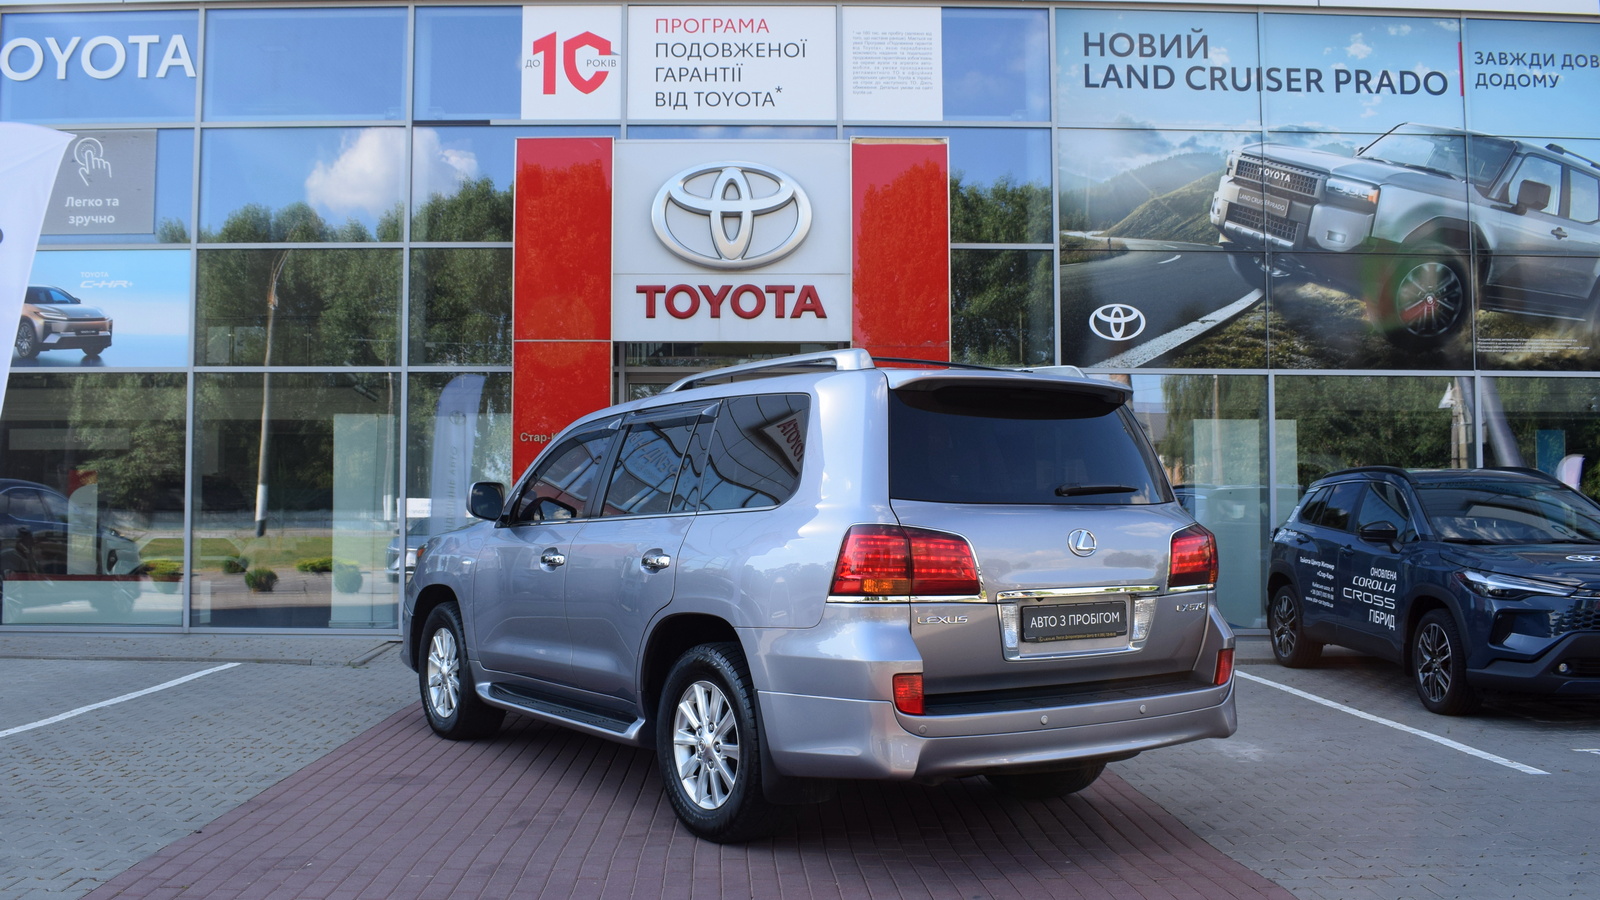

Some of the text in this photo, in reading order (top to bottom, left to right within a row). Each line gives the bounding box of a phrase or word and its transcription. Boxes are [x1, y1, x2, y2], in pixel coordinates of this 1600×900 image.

[655, 18, 770, 34] ПРОГРАМА
[655, 38, 808, 61] ПОДОВЖЕНОЇ
[1083, 28, 1209, 59] НОВИЙ
[525, 59, 541, 68] ДО
[586, 59, 617, 68] РОКІВ
[1474, 51, 1555, 70] ЗАВЖДИ
[655, 63, 744, 82] ГАРАНТІЇ
[1084, 64, 1448, 96] LAND CRUISER PRADO
[1475, 73, 1560, 90] ДОДОМУ
[655, 92, 688, 110] ВІД
[1258, 168, 1290, 182] TOYOTA
[64, 196, 120, 207] Легко та
[68, 215, 115, 226] зручно
[636, 284, 828, 319] TOYOTA
[1370, 567, 1397, 580] ОНОВЛЕНА
[1352, 576, 1396, 593] COROLLA
[1343, 587, 1396, 610] CROSS
[918, 616, 968, 624] LEXUS
[1030, 616, 1057, 628] АВТО
[1068, 612, 1120, 626] ПРОБІГОМ
